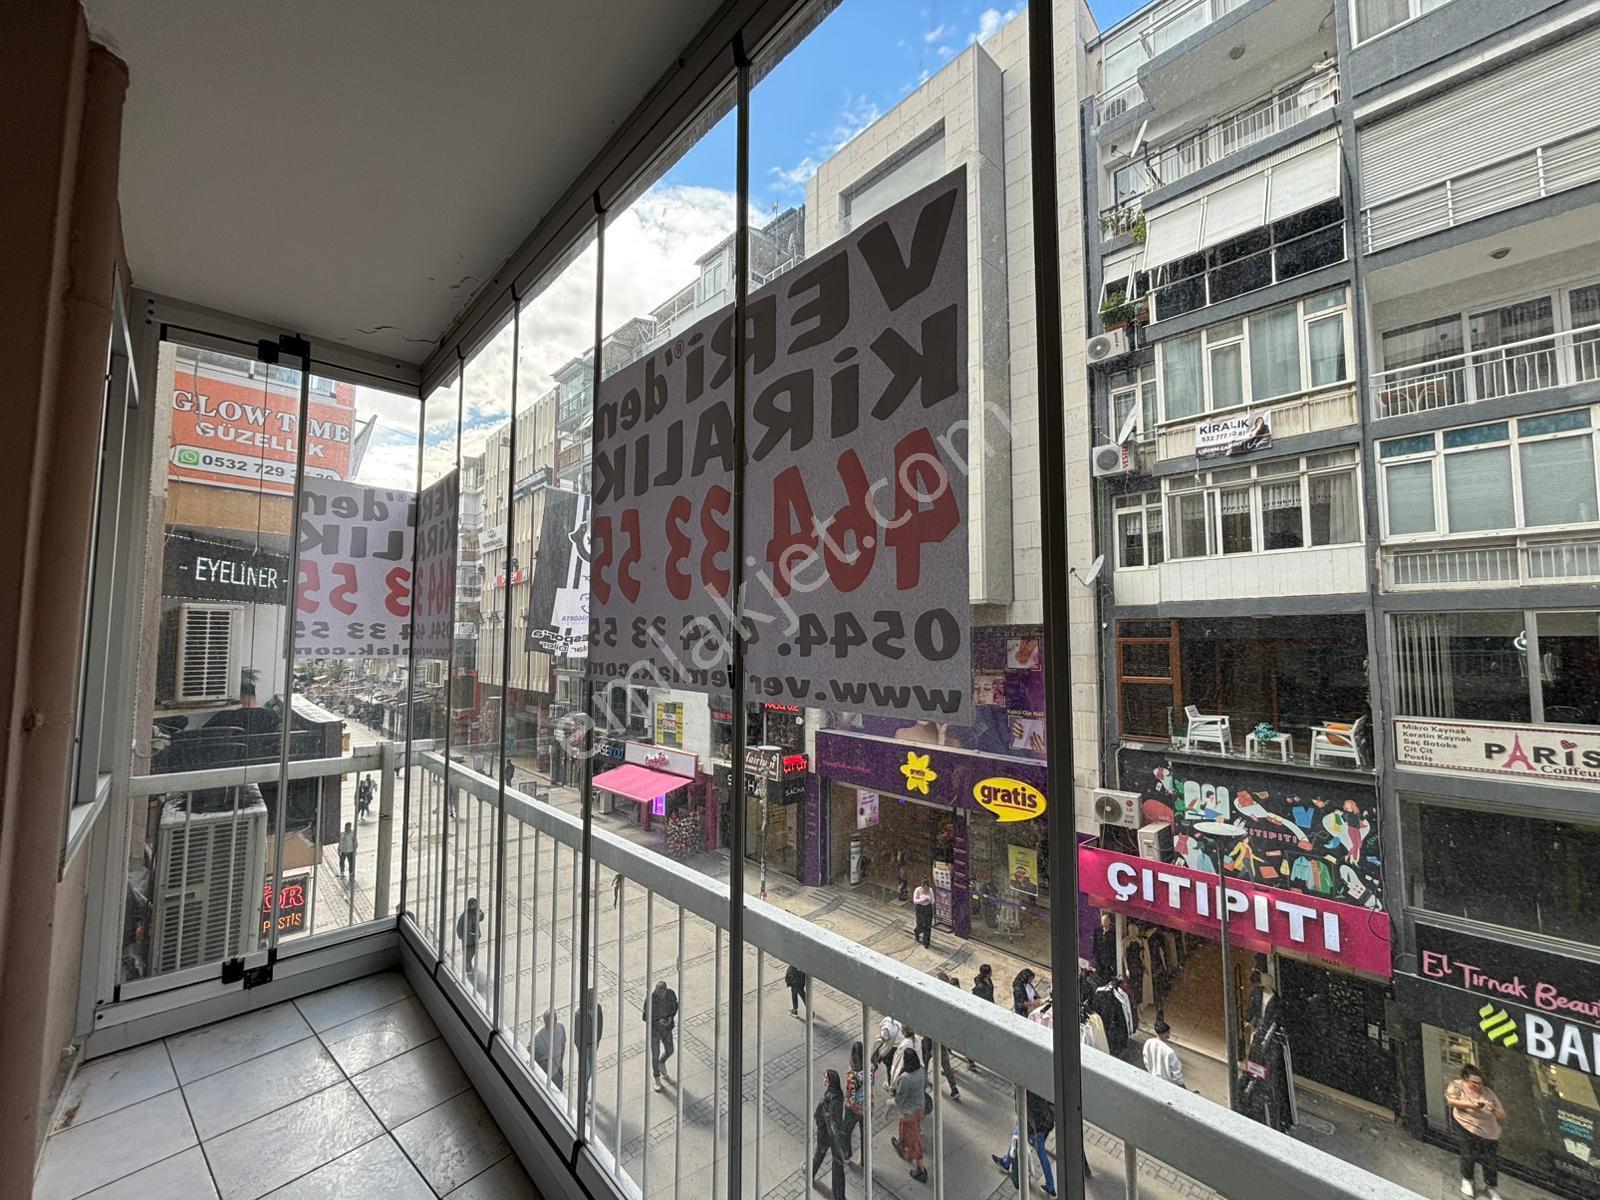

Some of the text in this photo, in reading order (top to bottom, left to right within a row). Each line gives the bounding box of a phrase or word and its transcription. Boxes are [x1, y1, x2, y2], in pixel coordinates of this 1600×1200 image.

[173, 390, 350, 443] GLOW TME
[1200, 418, 1249, 434] KİRALIK
[196, 423, 326, 457] GÜZELLK
[202, 454, 248, 472] 0532
[254, 463, 285, 477] 729
[1402, 724, 1467, 734] Mikro Kaynak
[1402, 731, 1472, 742] Keratin Kaynak
[1403, 739, 1458, 748] Saç Botoks
[1541, 764, 1600, 778] Coiffeu
[980, 784, 1038, 809] gratis
[1106, 862, 1341, 953] ÇITIPITI
[1422, 950, 1452, 978] El
[1453, 960, 1529, 999] Tırnak
